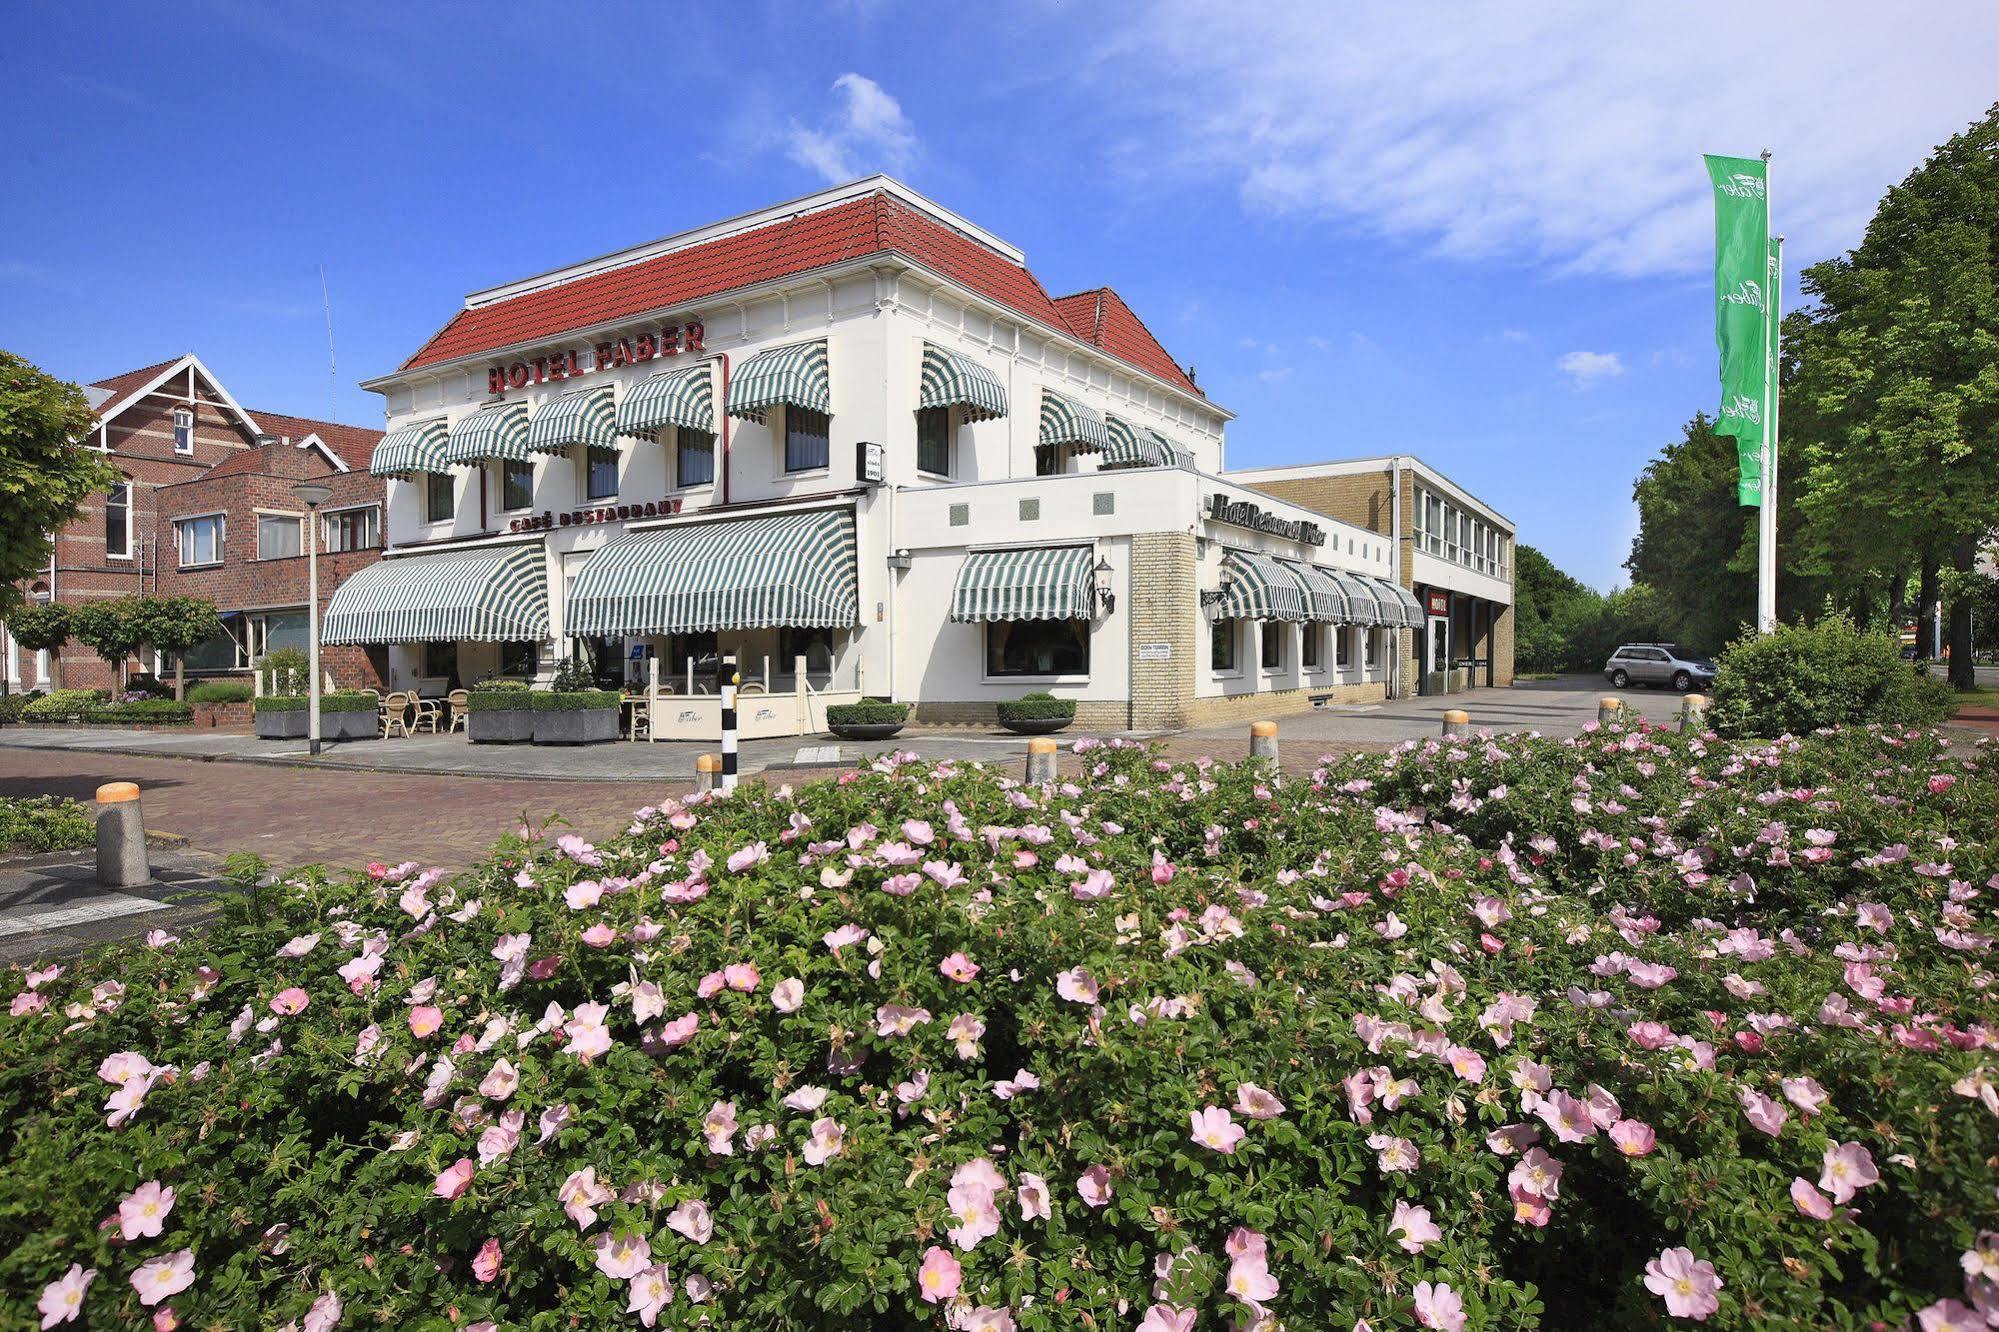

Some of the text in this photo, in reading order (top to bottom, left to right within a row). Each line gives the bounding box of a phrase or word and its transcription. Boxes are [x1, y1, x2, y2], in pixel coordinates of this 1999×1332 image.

[488, 322, 706, 394] HOTEL FABER
[559, 499, 683, 527] RESTAURANT
[1211, 493, 1251, 525] Hotel
